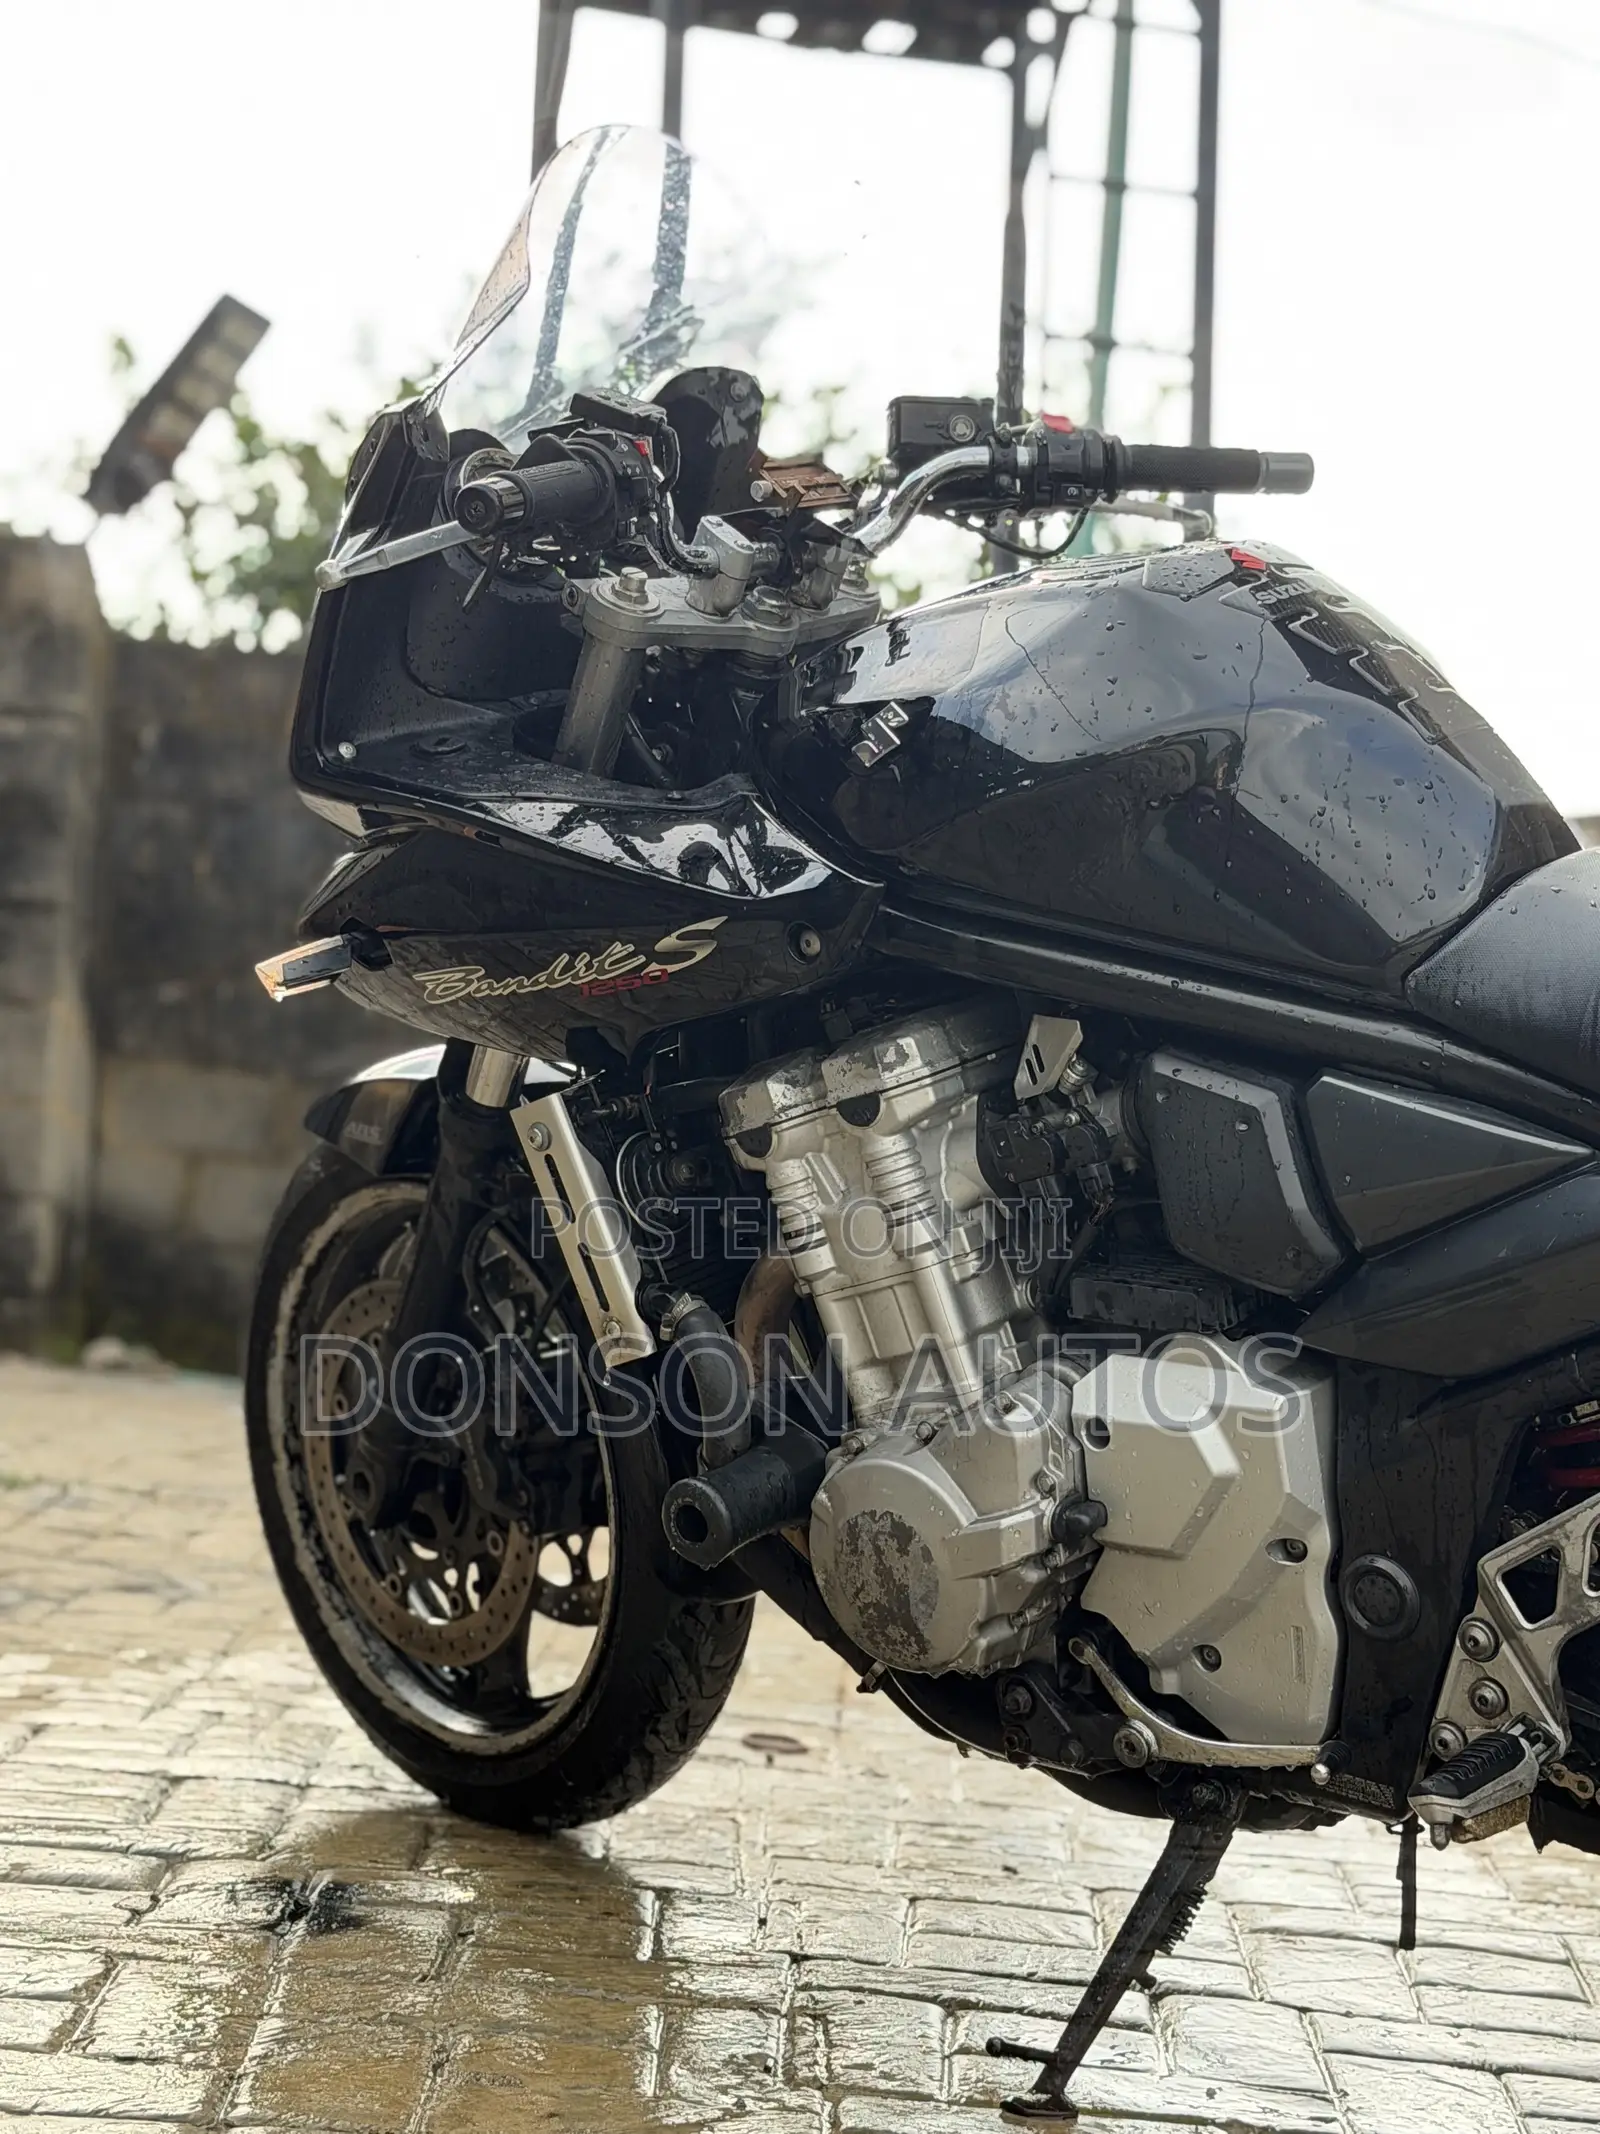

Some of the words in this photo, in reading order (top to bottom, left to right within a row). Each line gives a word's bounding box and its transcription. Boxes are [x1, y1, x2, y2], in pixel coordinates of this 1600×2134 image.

[1255, 581, 1314, 605] SUZU
[412, 941, 647, 1005] Bandit
[642, 916, 728, 976] S
[579, 968, 669, 998] 1250
